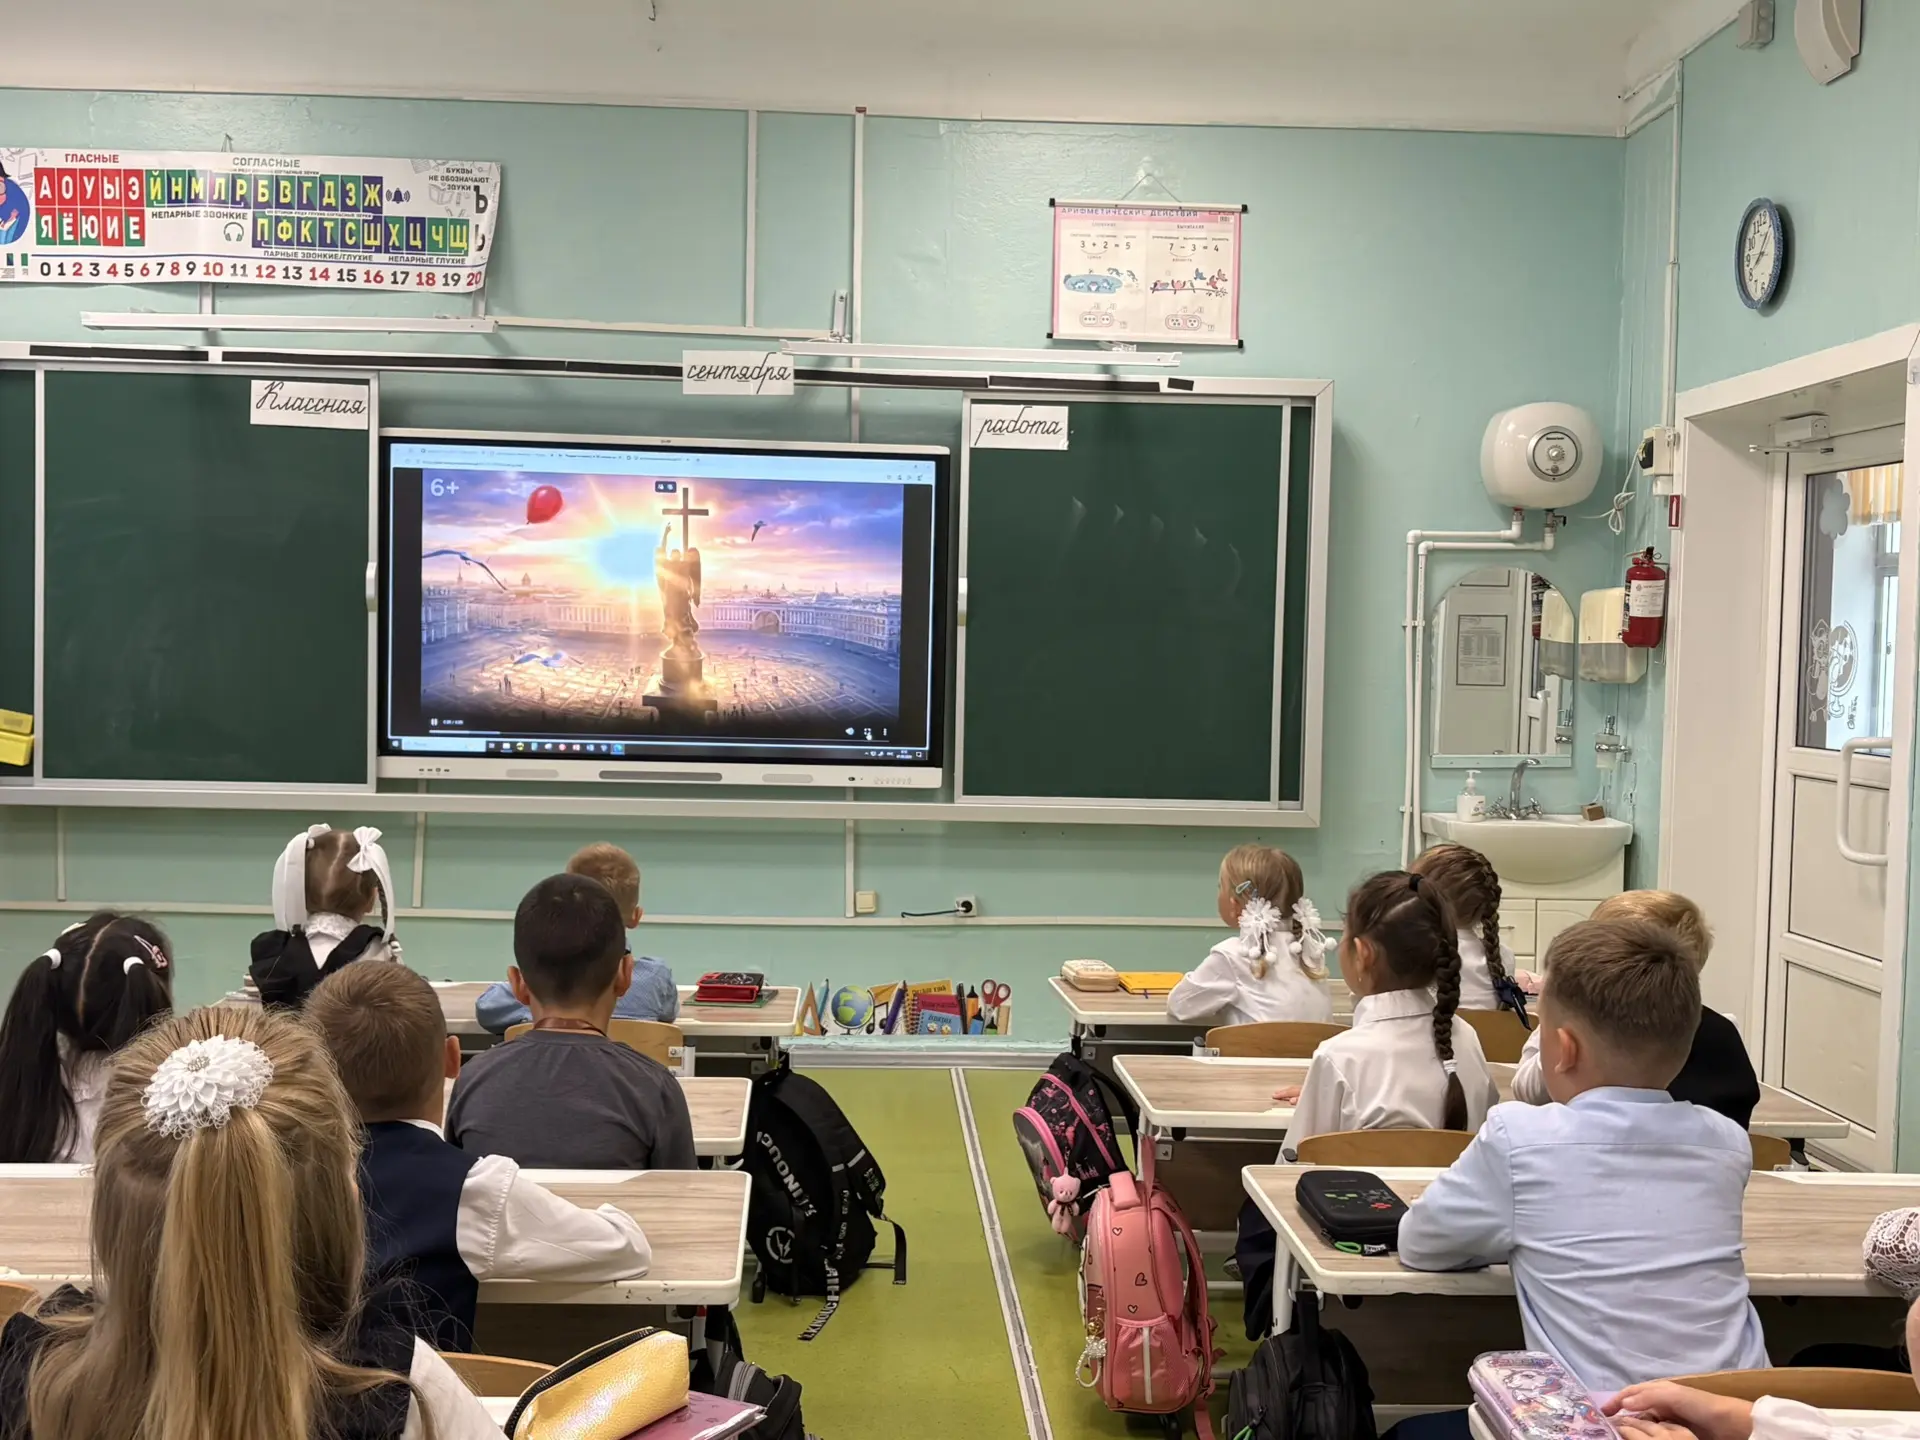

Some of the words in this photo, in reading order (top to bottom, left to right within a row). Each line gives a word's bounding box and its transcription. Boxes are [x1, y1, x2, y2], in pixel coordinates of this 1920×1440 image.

[65, 153, 119, 163] ГЛАСНЫЕ
[232, 157, 300, 168] СОГЛАСНЫЕ
[39, 176, 52, 199] А
[61, 175, 74, 200] О
[83, 175, 96, 199] У
[103, 176, 120, 200] Ы
[128, 176, 140, 200] Э
[152, 171, 162, 200] Й
[171, 178, 182, 199] Н
[190, 178, 204, 200] М
[211, 178, 226, 200] Л
[236, 179, 247, 201] Р
[257, 180, 270, 203] Б
[279, 181, 291, 204] В
[302, 181, 312, 204] Г
[322, 181, 336, 207] Д
[346, 183, 356, 206] З
[364, 183, 381, 207] Ж
[151, 210, 201, 219] НЕПАРНЫЕ
[203, 211, 248, 220] ЗВОНКИЕ
[1150, 209, 1198, 217] ДЕЙСТВИЯ
[40, 215, 52, 238] Я
[62, 211, 74, 241] Ё
[81, 215, 99, 239] Ю
[106, 215, 119, 239] И
[129, 215, 140, 239] Е
[256, 218, 269, 241] П
[277, 218, 292, 242] Ф
[301, 220, 312, 243] К
[323, 221, 334, 243] Т
[345, 221, 356, 245] С
[364, 223, 381, 246] Ш
[388, 223, 400, 247] Х
[409, 223, 421, 249] Ц
[432, 225, 443, 248] Ч
[450, 225, 467, 250] Щ
[1080, 240, 1085, 248] 3
[1103, 241, 1108, 249] 2
[1125, 242, 1131, 250] 5
[1169, 243, 1174, 251] 7
[1191, 244, 1196, 252] 3
[263, 250, 298, 259] ПАРНЫЕ
[301, 252, 373, 262] ЗВОНКИЕ/ГЛУХИЕ
[388, 255, 434, 264] НЕПАРНЫЕ
[436, 256, 466, 265] ГЛУХИЕ
[40, 262, 50, 276] 0
[57, 262, 66, 276] 1
[72, 262, 83, 277] 2
[89, 262, 100, 277] 3
[107, 263, 118, 277] 4
[124, 263, 134, 277] 5
[140, 262, 150, 277] 6
[156, 262, 165, 276] 7
[170, 261, 180, 275] 8
[186, 261, 196, 275] 9
[203, 262, 223, 276] 10
[230, 264, 248, 277] 11
[255, 264, 276, 279] 12
[282, 266, 302, 280] 13
[309, 267, 330, 282] 14
[337, 268, 357, 283] 15
[363, 269, 384, 284] 16
[390, 270, 410, 285] 17
[415, 271, 436, 286] 18
[441, 272, 461, 287] 19
[466, 271, 482, 286] 20
[687, 351, 791, 395] сентября
[256, 381, 366, 414] Классная
[974, 406, 1062, 446] работа
[430, 477, 460, 497] 6+
